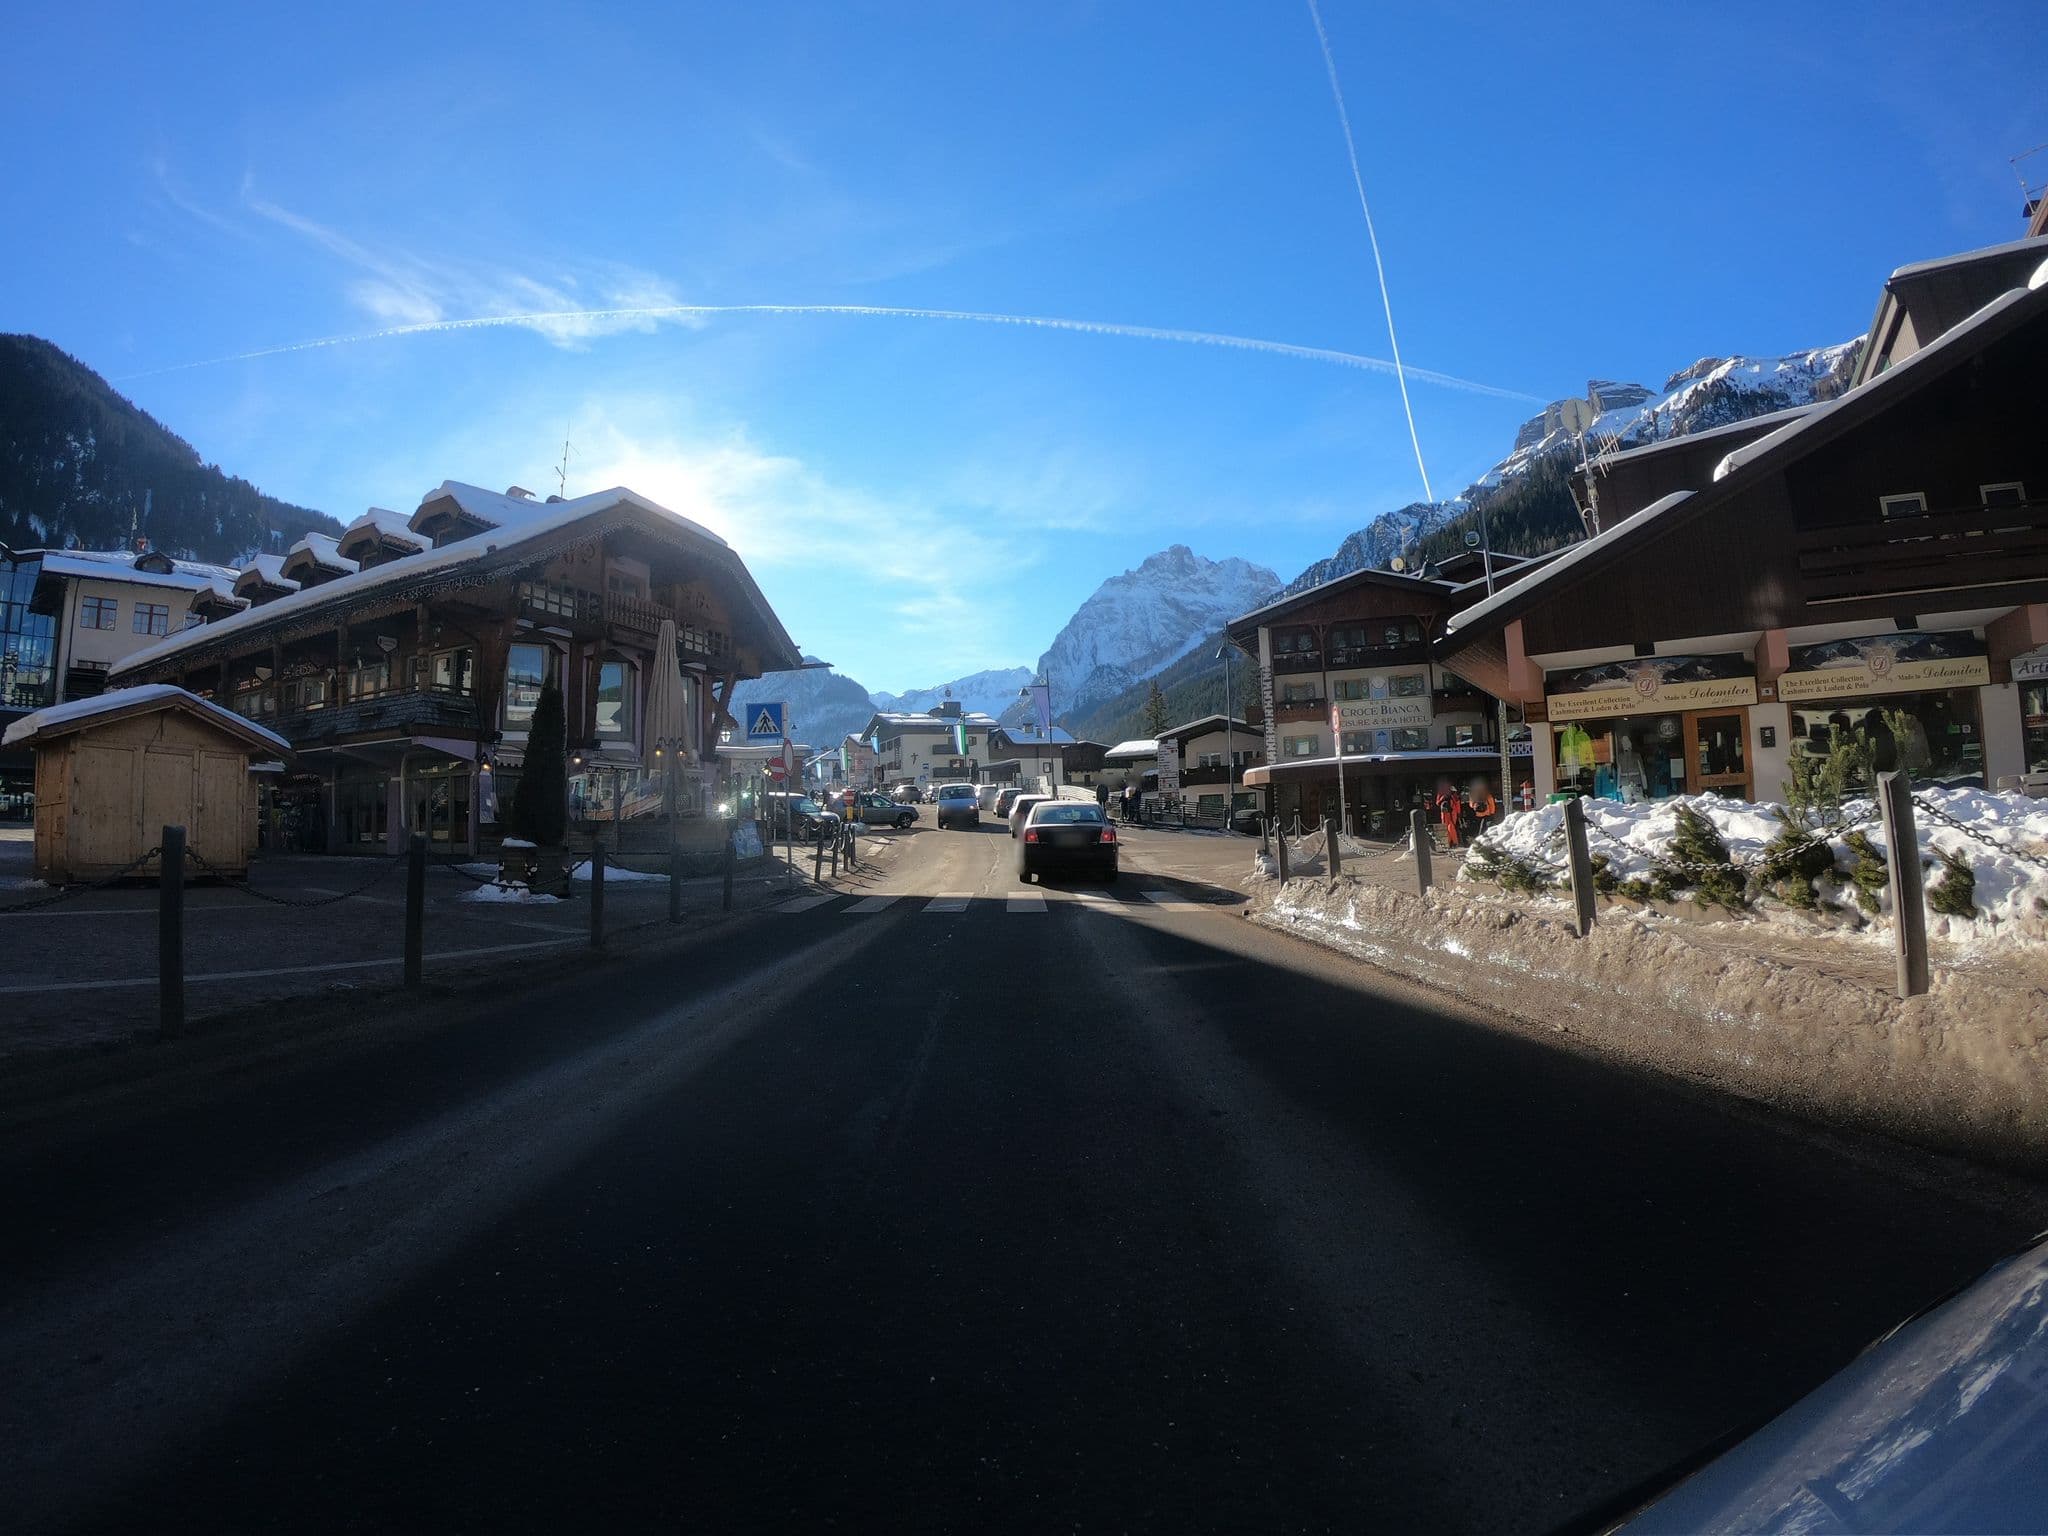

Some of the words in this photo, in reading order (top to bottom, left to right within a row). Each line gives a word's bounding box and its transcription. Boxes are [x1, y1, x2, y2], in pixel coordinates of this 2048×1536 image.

[1922, 664, 1982, 678] Dolomiten
[1784, 680, 1798, 688] The
[1799, 678, 1830, 686] Excellent
[1830, 674, 1864, 683] Collection
[1689, 685, 1749, 699] Dolomiten
[1780, 687, 1813, 695] Cashmere
[1567, 697, 1598, 706] Excellent
[1598, 695, 1632, 704] Collection
[1341, 706, 1379, 717] CROCE
[1380, 704, 1421, 715] BIANCA
[1550, 708, 1582, 716] Cashmere
[1381, 716, 1398, 725] SPA
[1399, 715, 1430, 724] HOTEL
